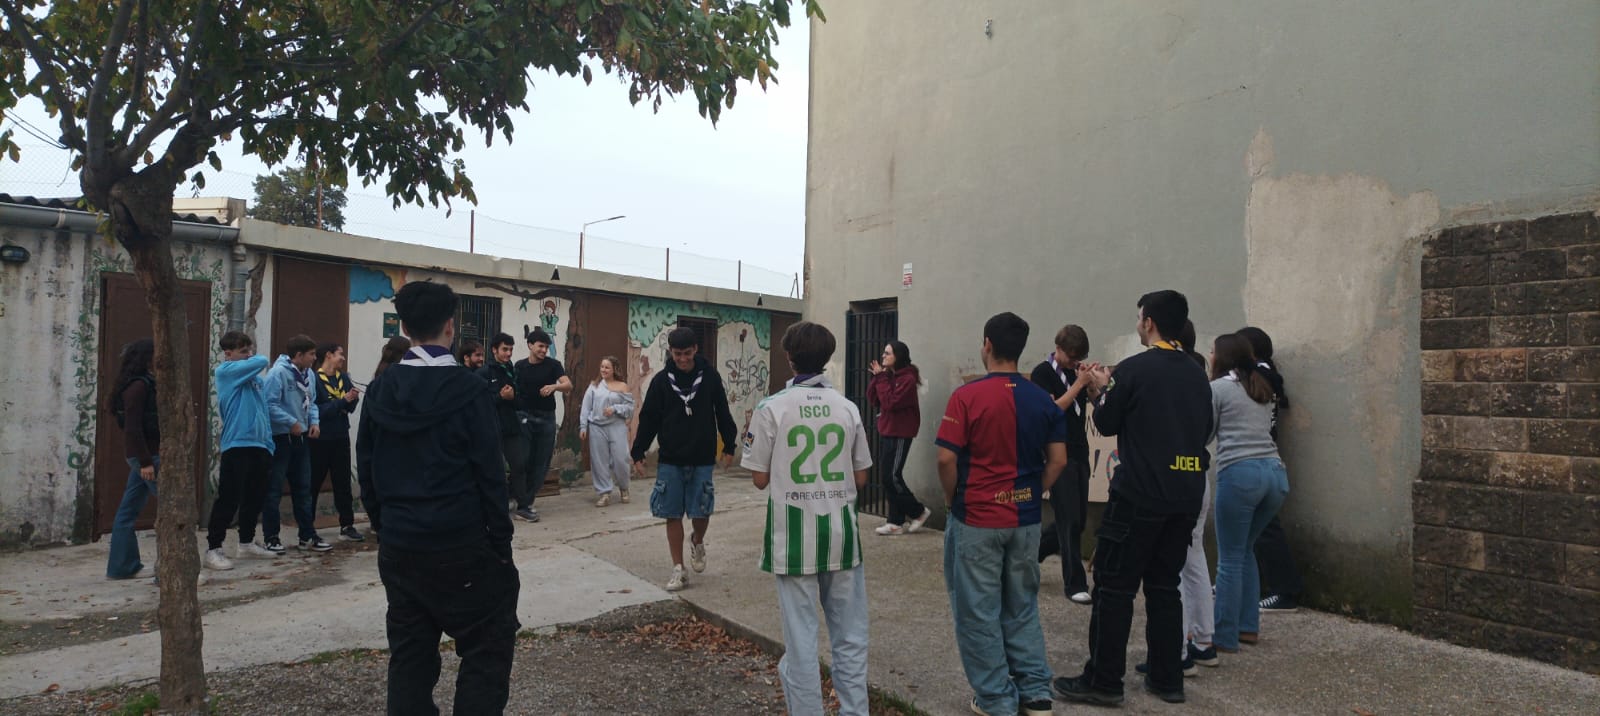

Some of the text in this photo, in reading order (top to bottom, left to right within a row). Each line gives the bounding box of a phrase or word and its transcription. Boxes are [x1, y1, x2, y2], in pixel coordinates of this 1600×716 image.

[799, 404, 831, 419] ISCO
[787, 423, 846, 484] 22
[1169, 455, 1202, 472] JOEL
[785, 490, 827, 500] FOREVER
